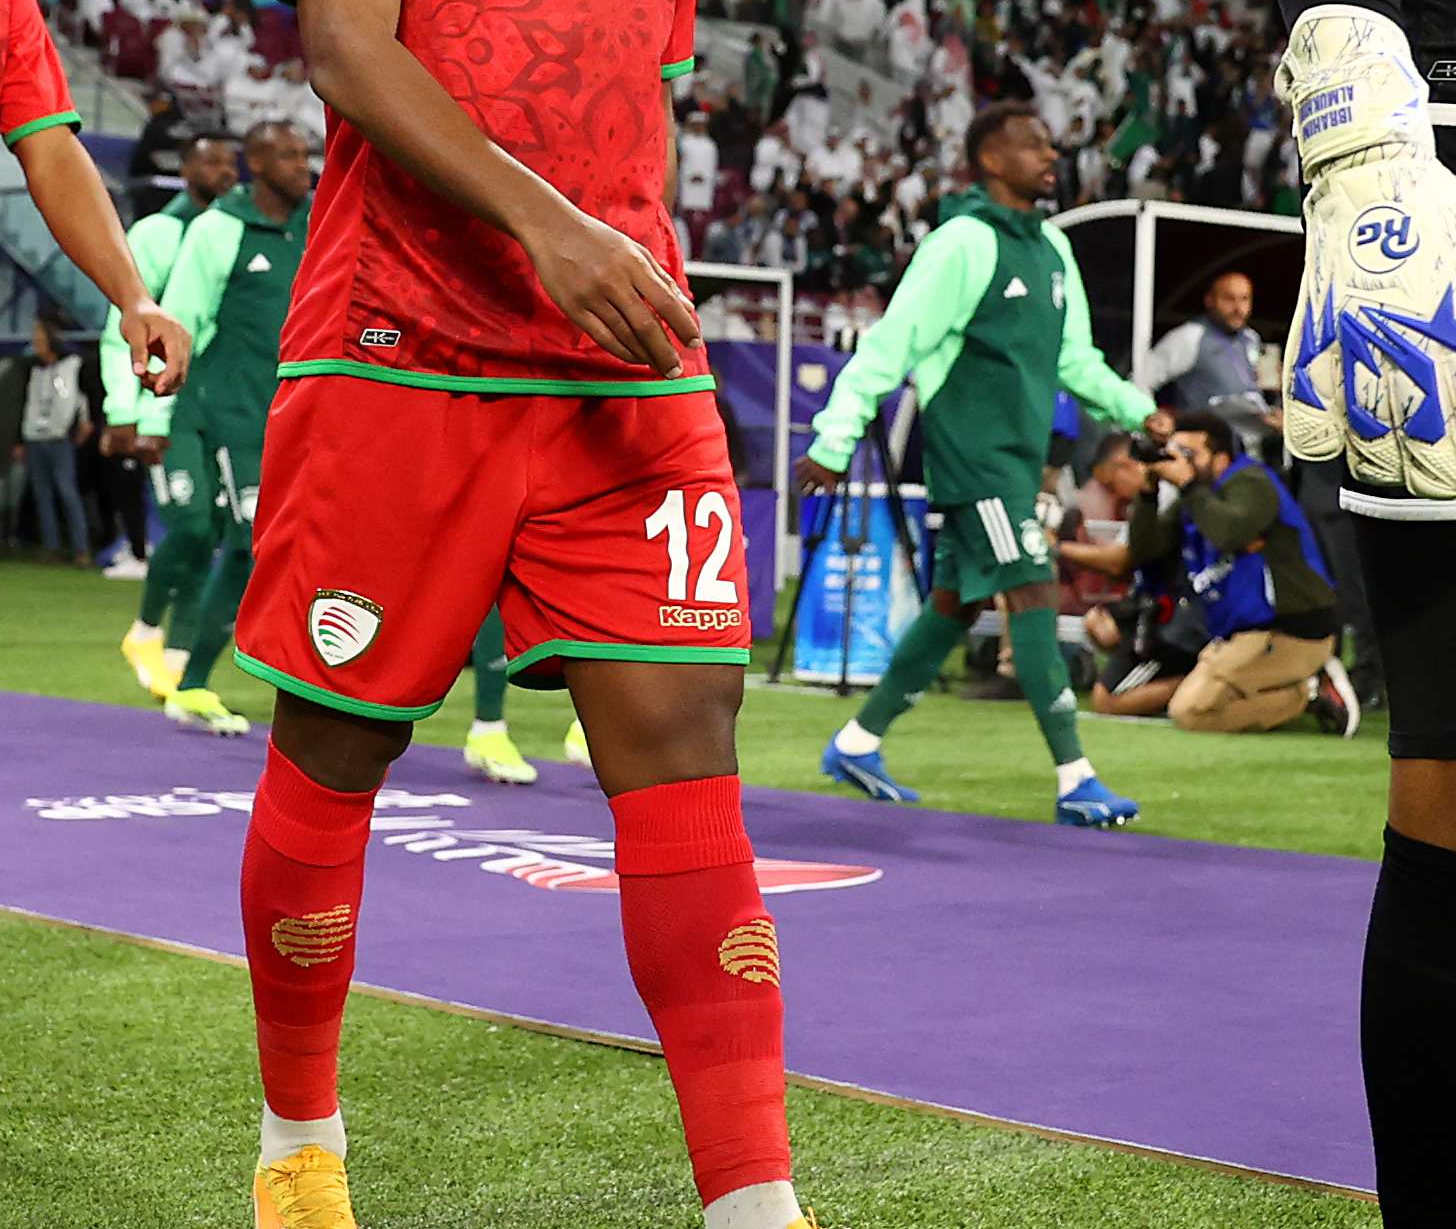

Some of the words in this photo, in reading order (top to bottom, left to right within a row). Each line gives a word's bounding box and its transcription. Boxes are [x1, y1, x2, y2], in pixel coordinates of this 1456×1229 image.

[1356, 215, 1420, 260] RG
[645, 490, 739, 604] 12
[659, 606, 742, 630] Kappa
